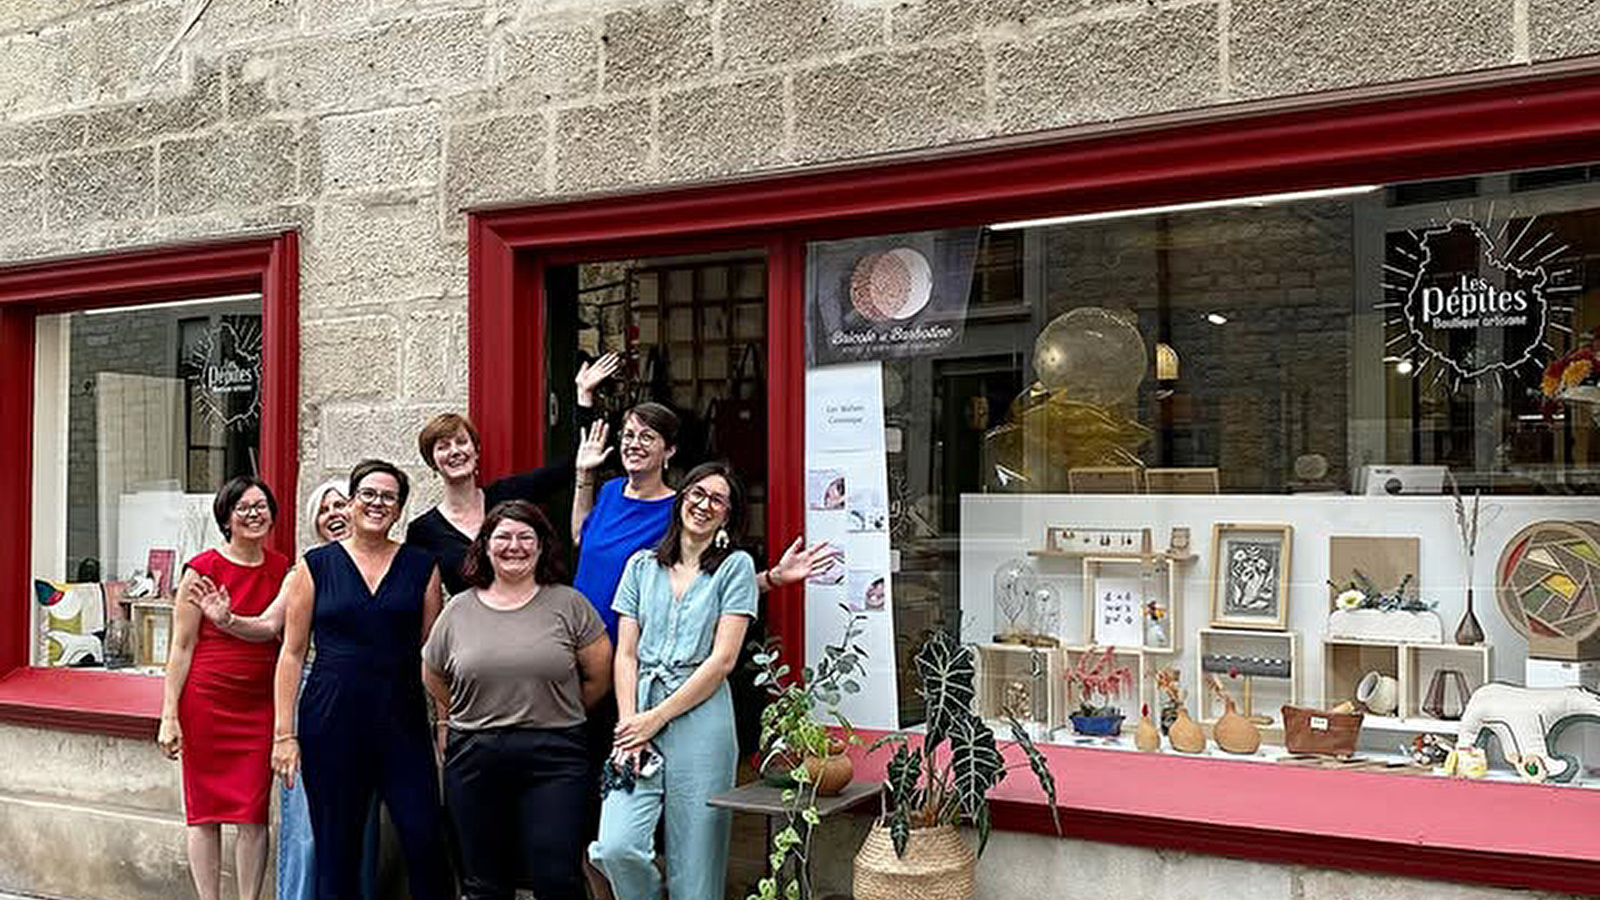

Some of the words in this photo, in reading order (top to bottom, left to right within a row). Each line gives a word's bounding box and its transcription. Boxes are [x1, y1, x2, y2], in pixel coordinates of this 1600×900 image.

[1461, 275, 1488, 292] Les
[1423, 285, 1528, 323] Pépites
[1432, 317, 1480, 329] Boutique
